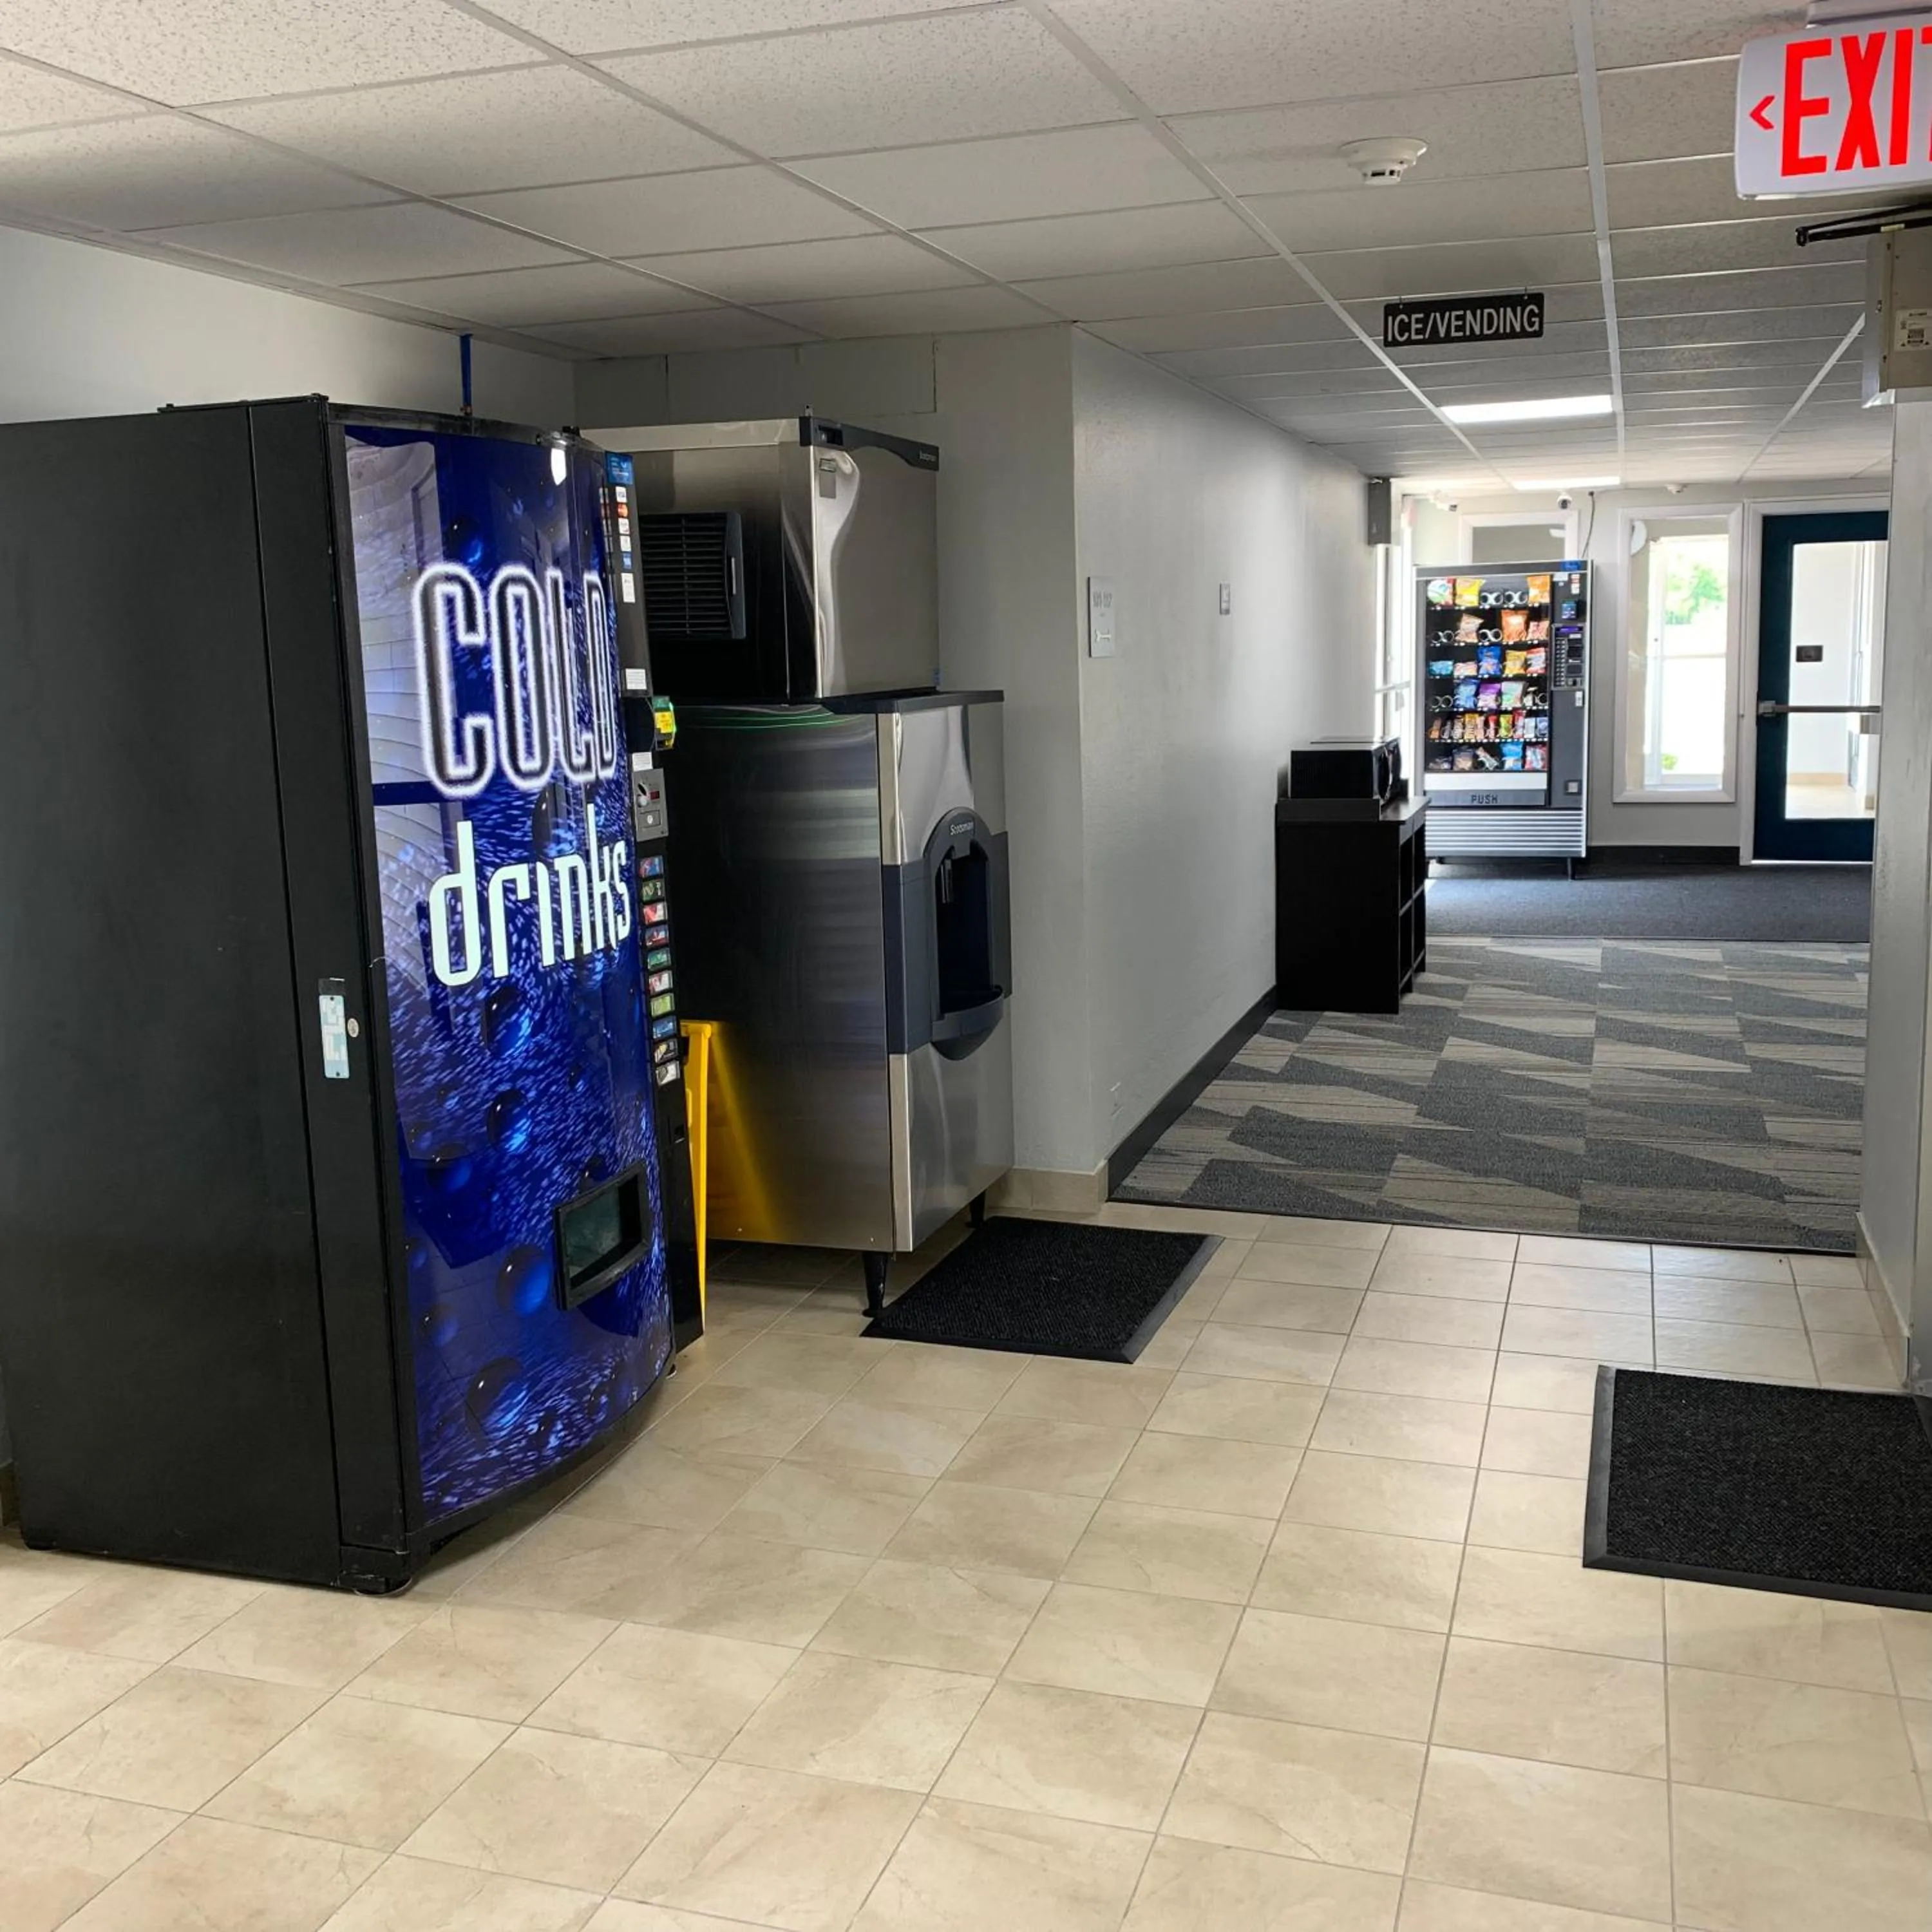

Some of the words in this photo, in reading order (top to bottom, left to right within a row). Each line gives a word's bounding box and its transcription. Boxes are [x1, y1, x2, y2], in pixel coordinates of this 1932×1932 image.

[1781, 26, 1932, 176] EXI
[1387, 305, 1540, 342] ICE/VENDING
[411, 562, 617, 799] COLD
[1471, 794, 1498, 804] PUSH
[429, 803, 630, 987] drinks
